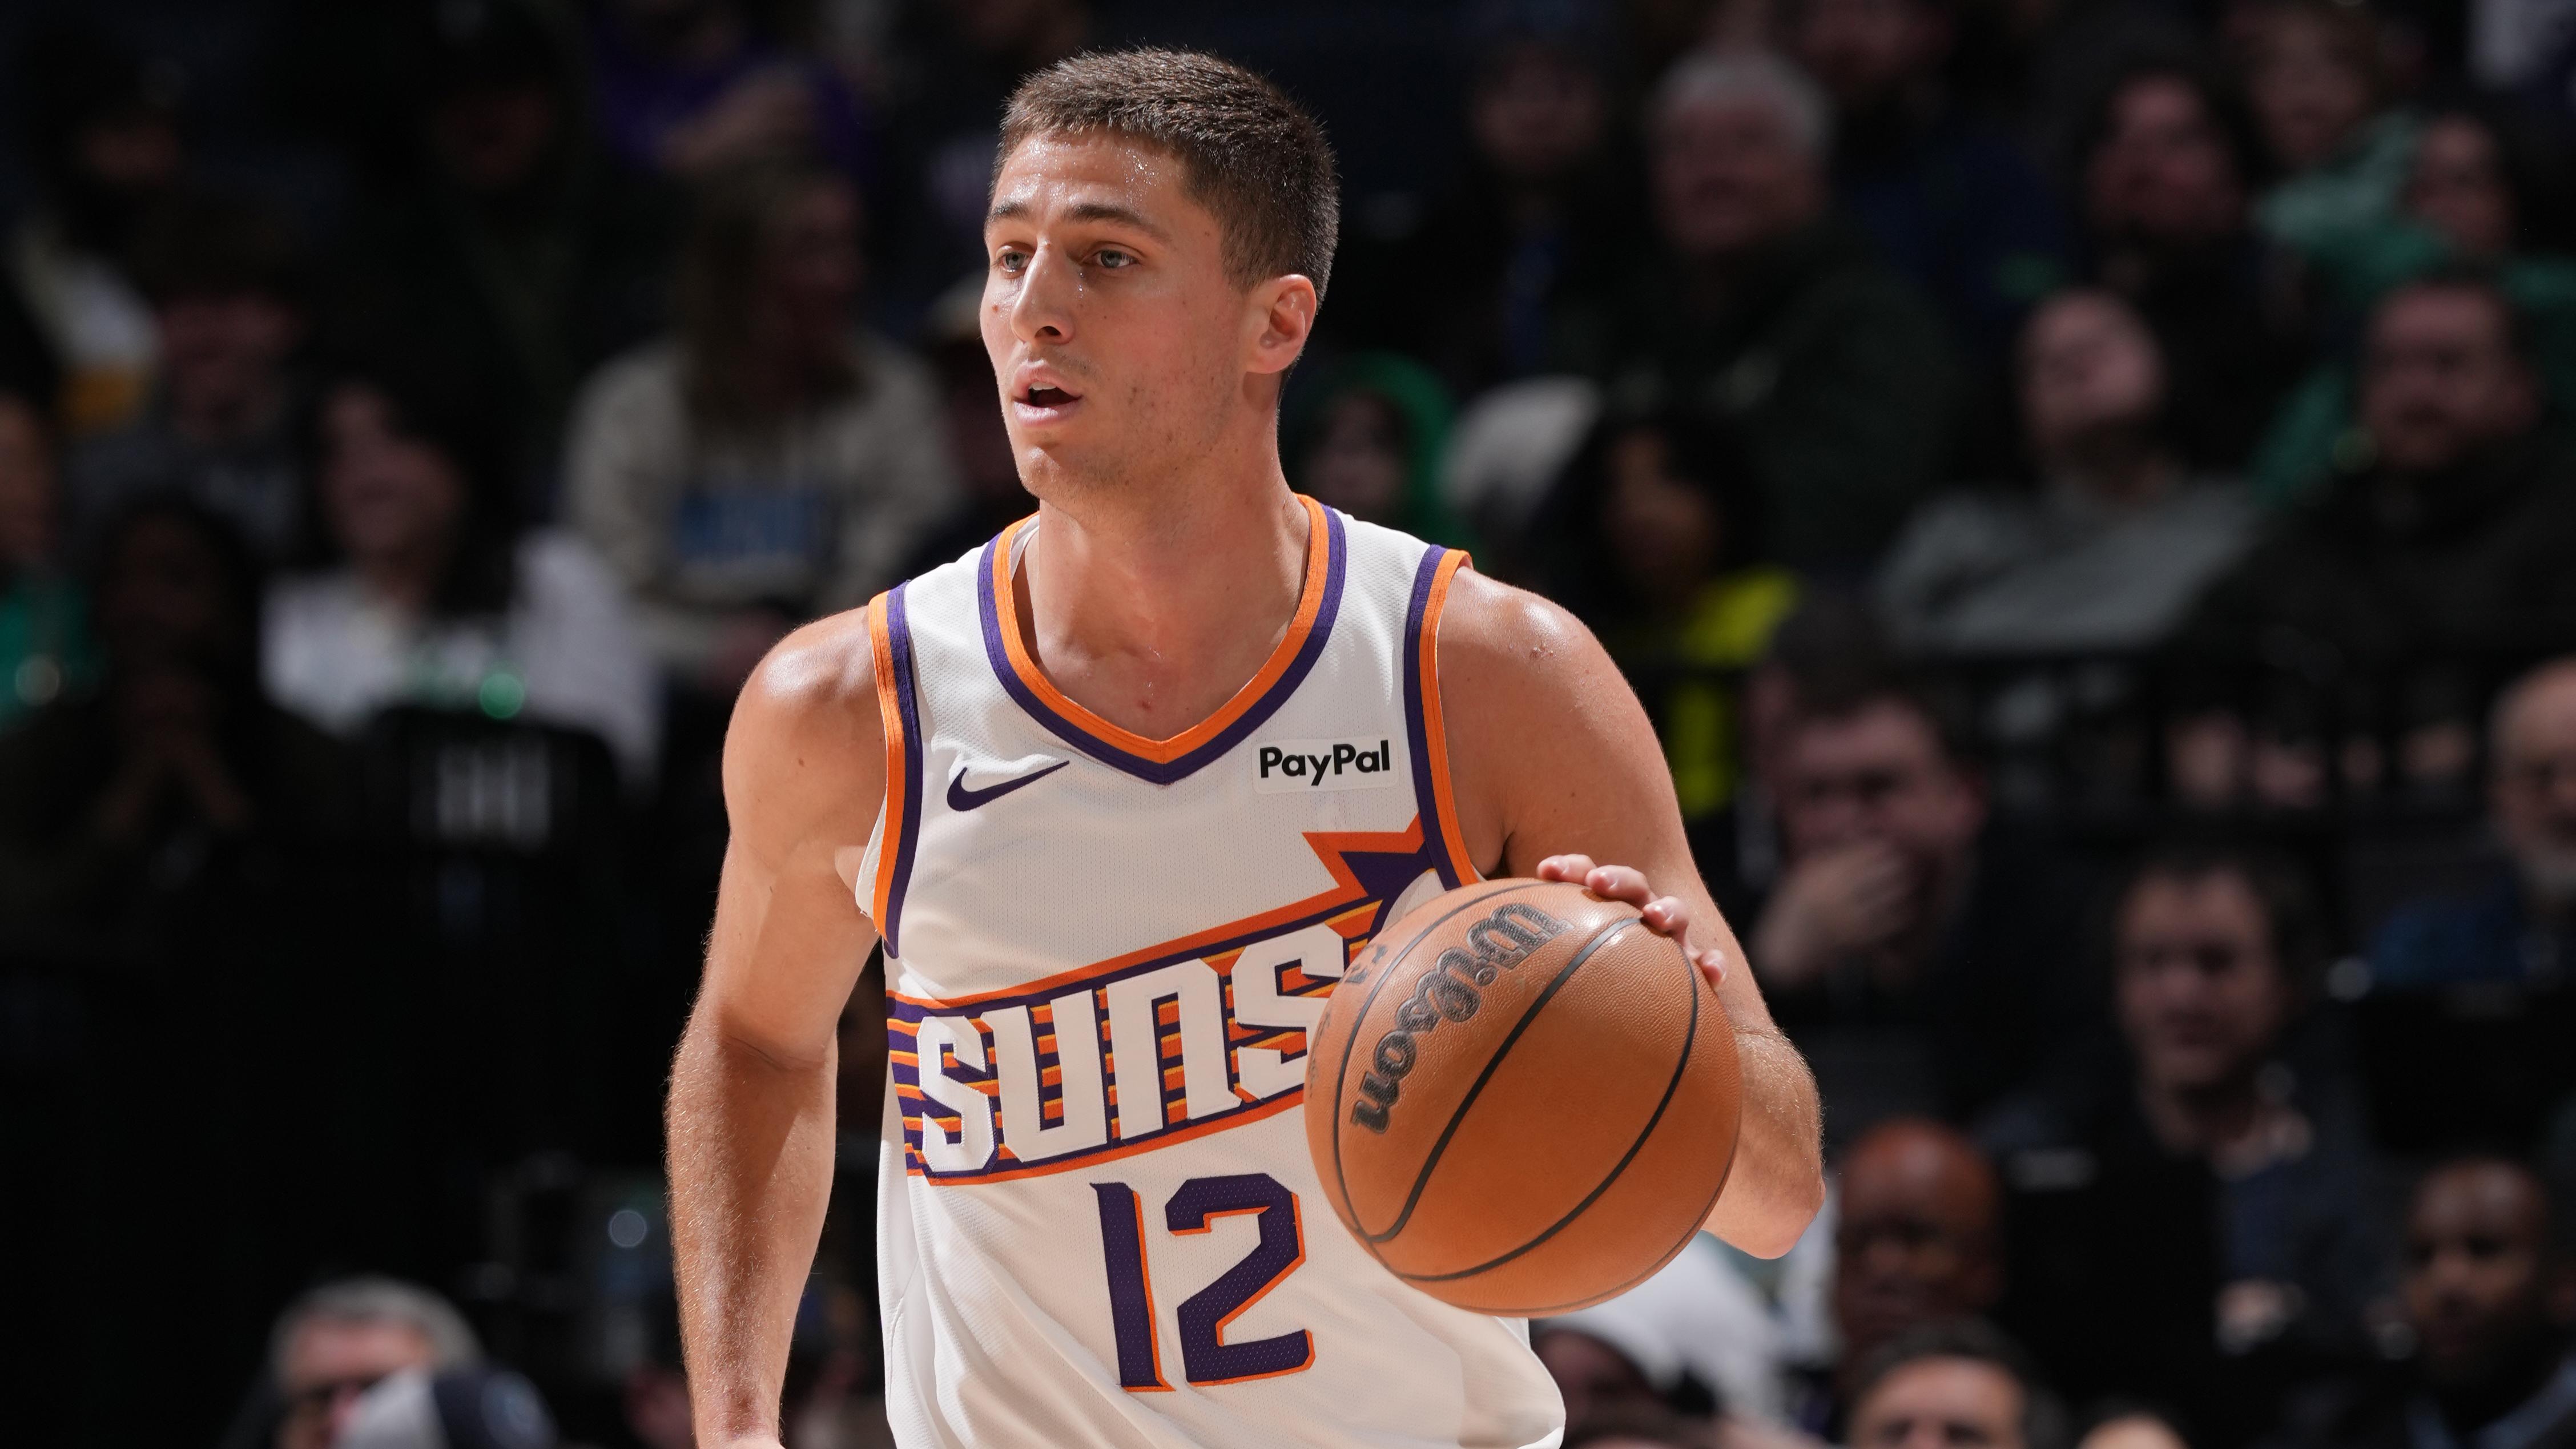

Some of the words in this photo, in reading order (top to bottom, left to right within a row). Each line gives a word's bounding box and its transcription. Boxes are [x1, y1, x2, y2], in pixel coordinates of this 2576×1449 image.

[1259, 739, 1390, 786] PayPal
[1351, 903, 1575, 1134] Wilson
[1089, 1173, 1316, 1392] 12
